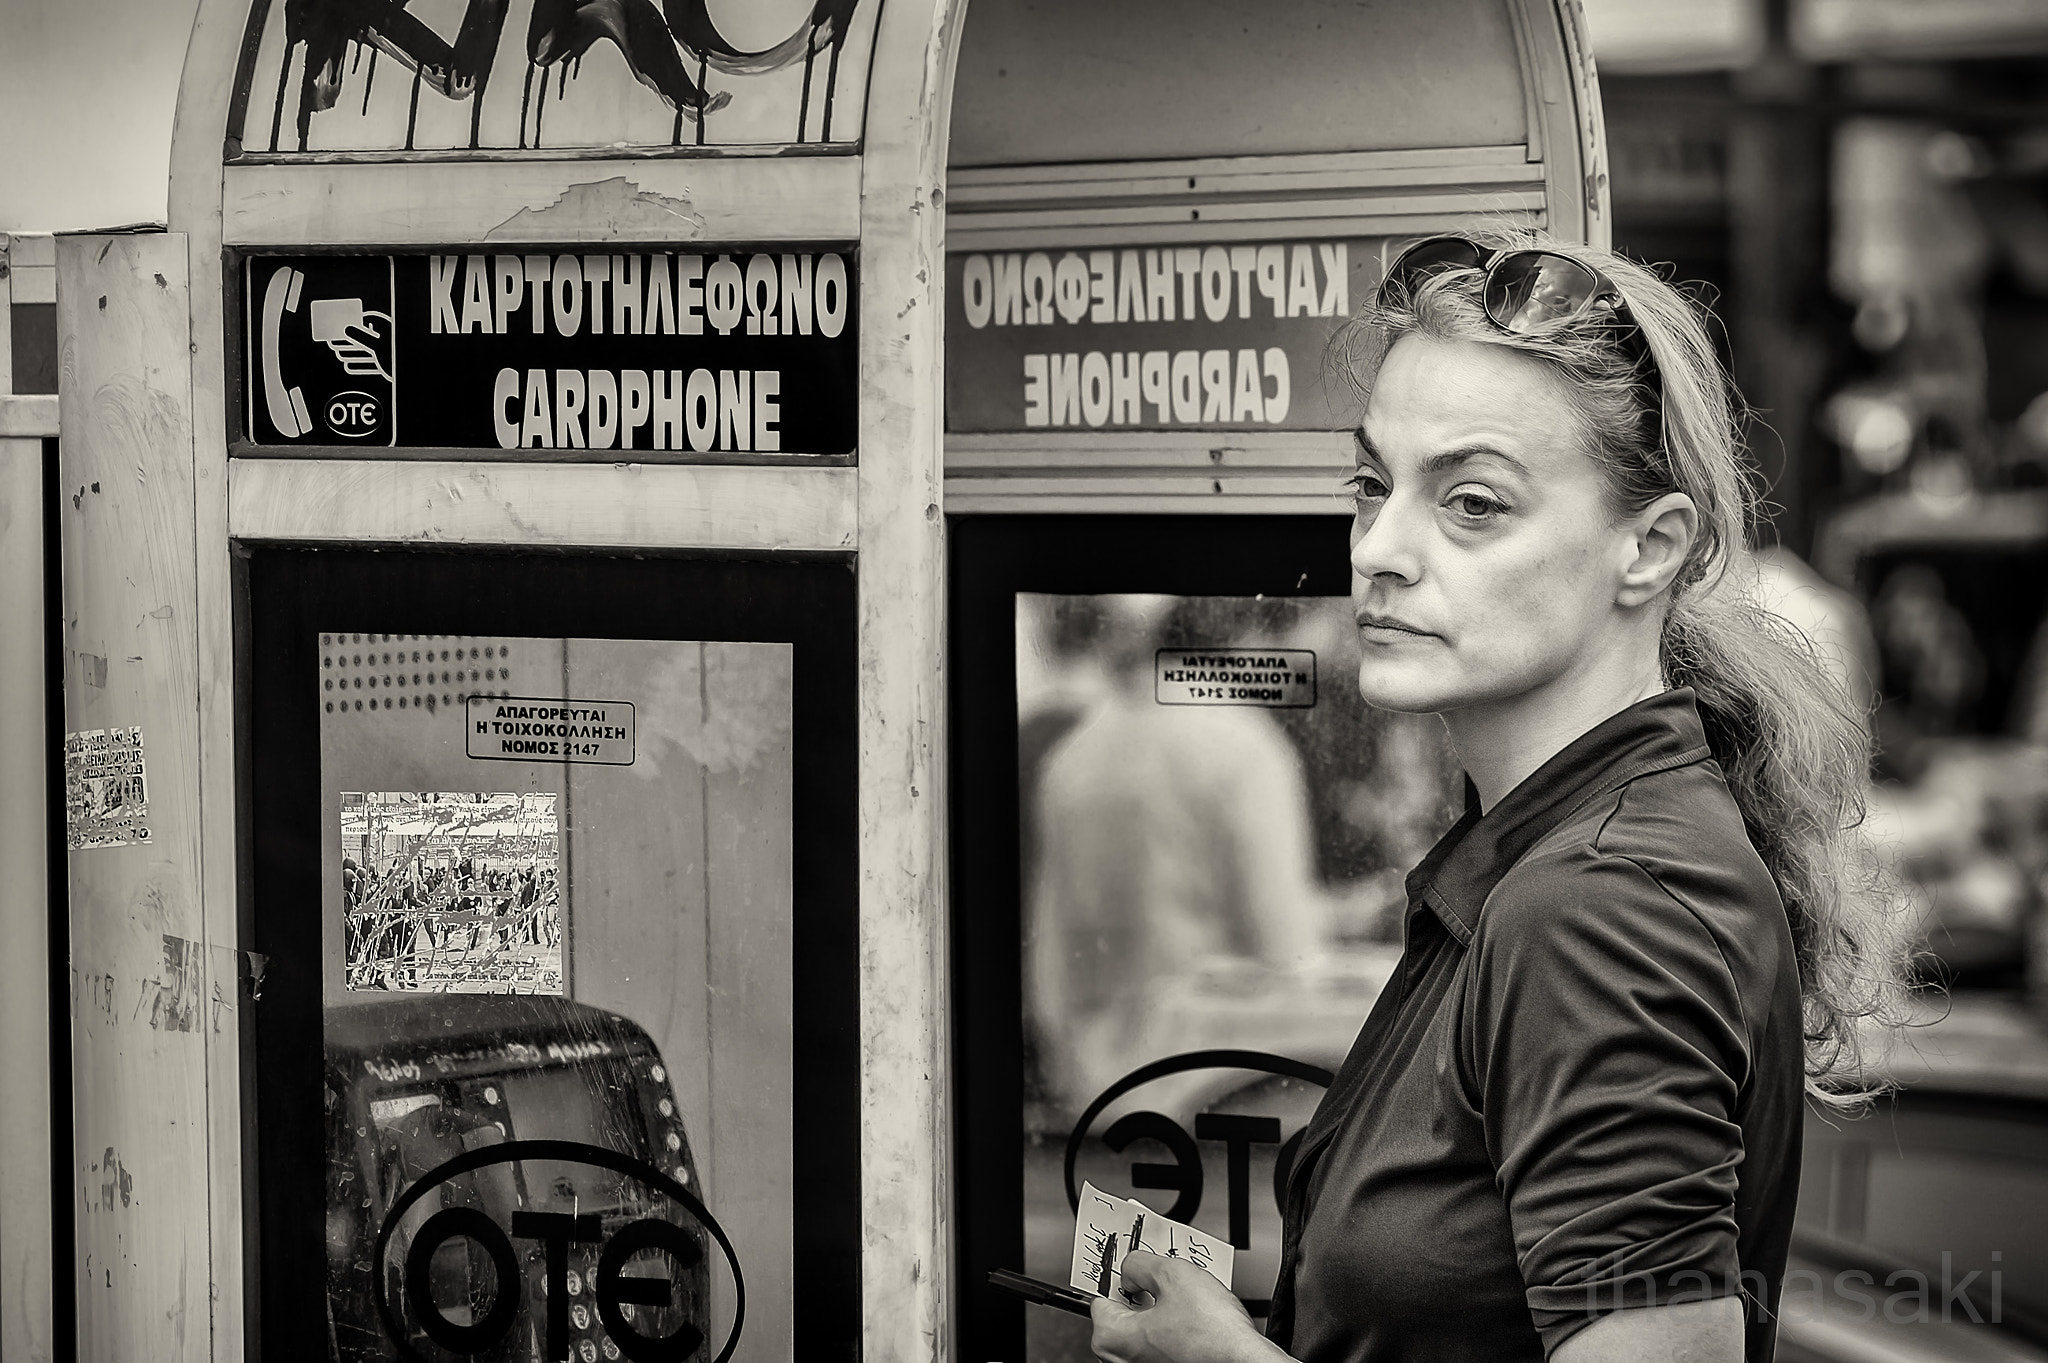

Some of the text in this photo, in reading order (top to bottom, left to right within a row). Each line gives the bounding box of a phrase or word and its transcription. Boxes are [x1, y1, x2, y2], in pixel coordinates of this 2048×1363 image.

[429, 254, 848, 338] ΚΑΡΤΟΤΗΛΕΦΩΝΟ
[494, 367, 781, 452] CARDPHONE
[495, 705, 606, 722] ΑΠΑΓΟΡΕΥΤΑΙ
[476, 721, 626, 740] Η ΤΟΙΧΟΚΟΛΛΗΣΗ
[501, 739, 600, 756] ΝΟΜΟΣ 2147
